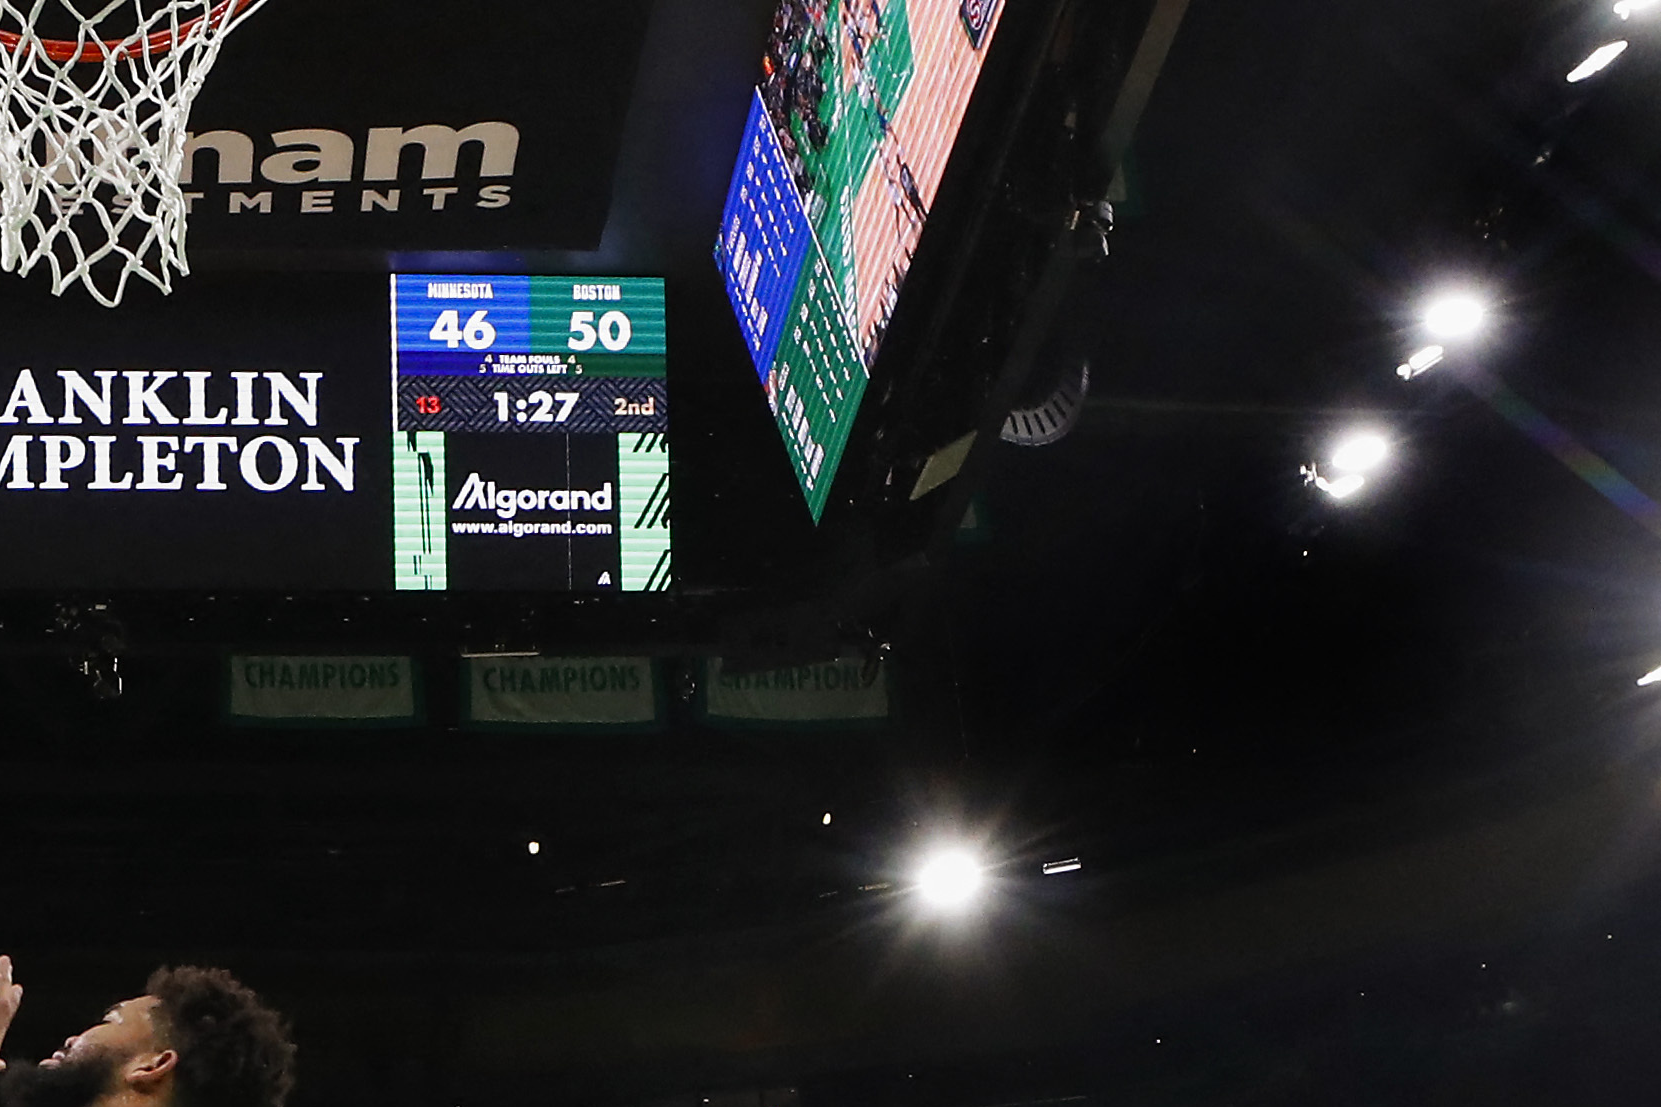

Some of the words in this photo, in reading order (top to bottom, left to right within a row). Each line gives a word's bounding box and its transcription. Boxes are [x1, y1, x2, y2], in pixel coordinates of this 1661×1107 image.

[427, 282, 494, 299] MINNESOTA
[572, 284, 621, 301] BOSTON
[428, 309, 497, 350] 46
[567, 310, 632, 352] 50
[492, 364, 516, 373] TIME
[517, 364, 544, 373] OUTS
[546, 364, 568, 374] LEFT
[499, 355, 526, 363] TEAM
[528, 355, 560, 364] FOULS
[417, 397, 440, 414] 13
[494, 391, 580, 422] 1:27
[614, 397, 655, 416] 2nd
[452, 472, 612, 519] Algorand
[452, 520, 612, 537] www.algorand.com
[244, 662, 400, 690] CHAMPIONS
[482, 665, 641, 693] CHAMPIONS
